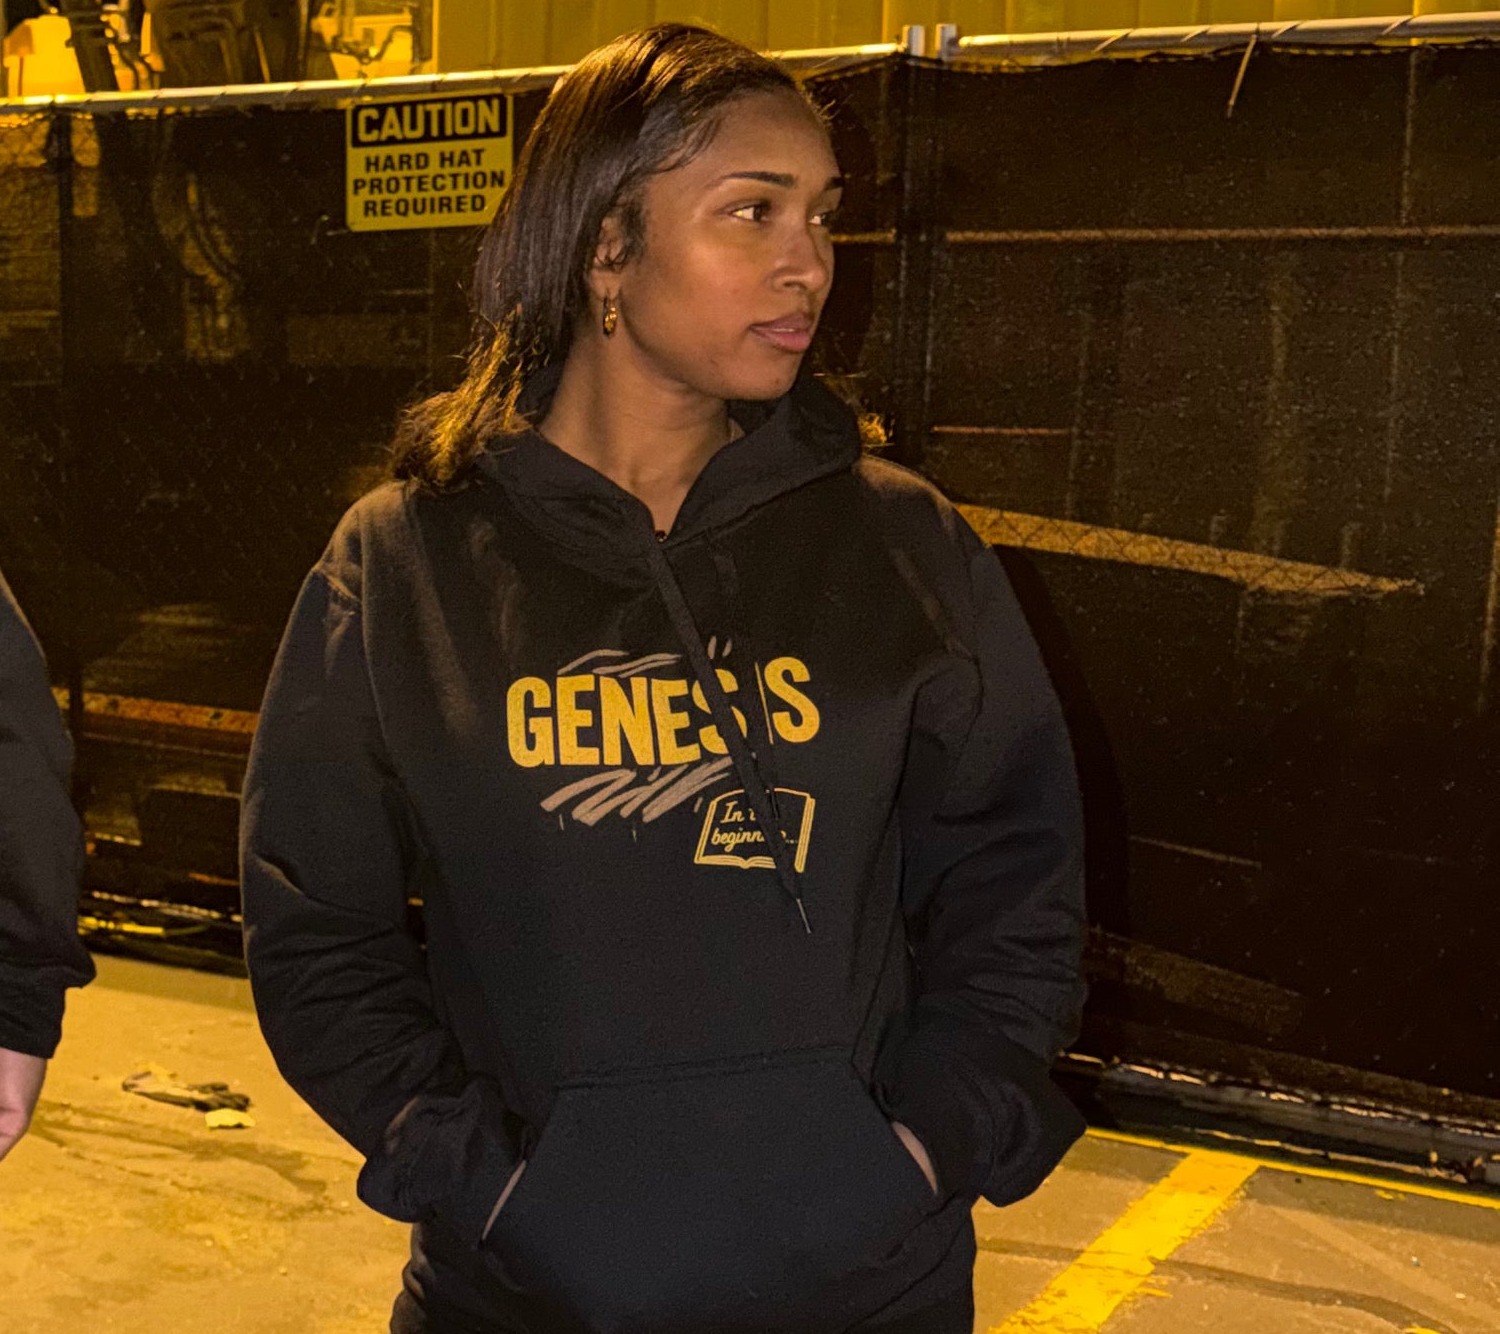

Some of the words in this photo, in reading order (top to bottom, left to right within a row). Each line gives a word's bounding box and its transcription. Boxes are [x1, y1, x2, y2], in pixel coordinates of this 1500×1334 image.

[357, 98, 500, 143] CAUTION
[365, 153, 429, 173] HARD
[439, 149, 485, 170] HAT
[353, 171, 505, 196] PROTECTION
[364, 195, 486, 217] REQUIRED
[506, 656, 820, 768] GENESS
[721, 800, 745, 823] In
